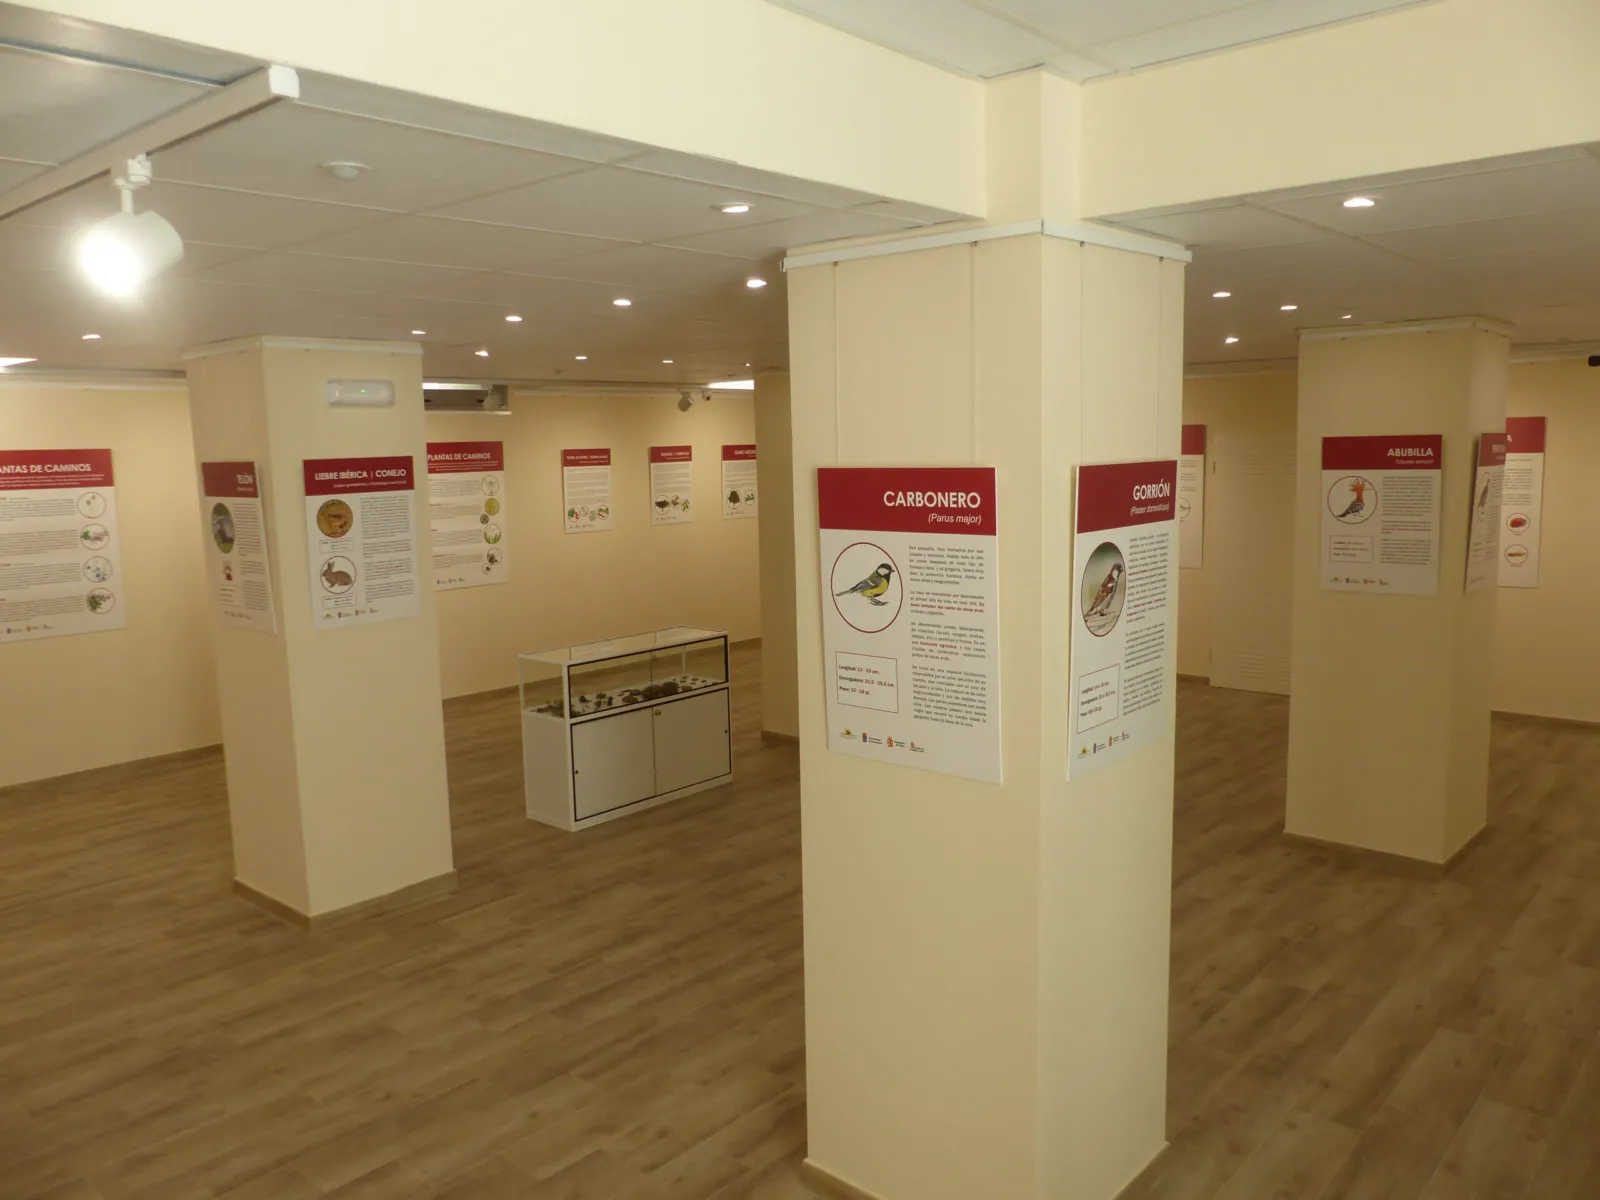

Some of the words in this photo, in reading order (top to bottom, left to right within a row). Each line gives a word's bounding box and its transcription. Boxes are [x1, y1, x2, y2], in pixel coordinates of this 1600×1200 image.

[1387, 448, 1434, 456] ABUBILLA
[44, 464, 91, 472] CAMINOS
[315, 472, 338, 480] LIEBRE
[339, 470, 368, 479] IBÉRICA
[375, 469, 406, 477] CONEJO
[1133, 479, 1170, 500] GORRIÓN
[883, 491, 981, 508] CARBONERO
[928, 513, 954, 523] (Parus
[956, 515, 982, 525] major)
